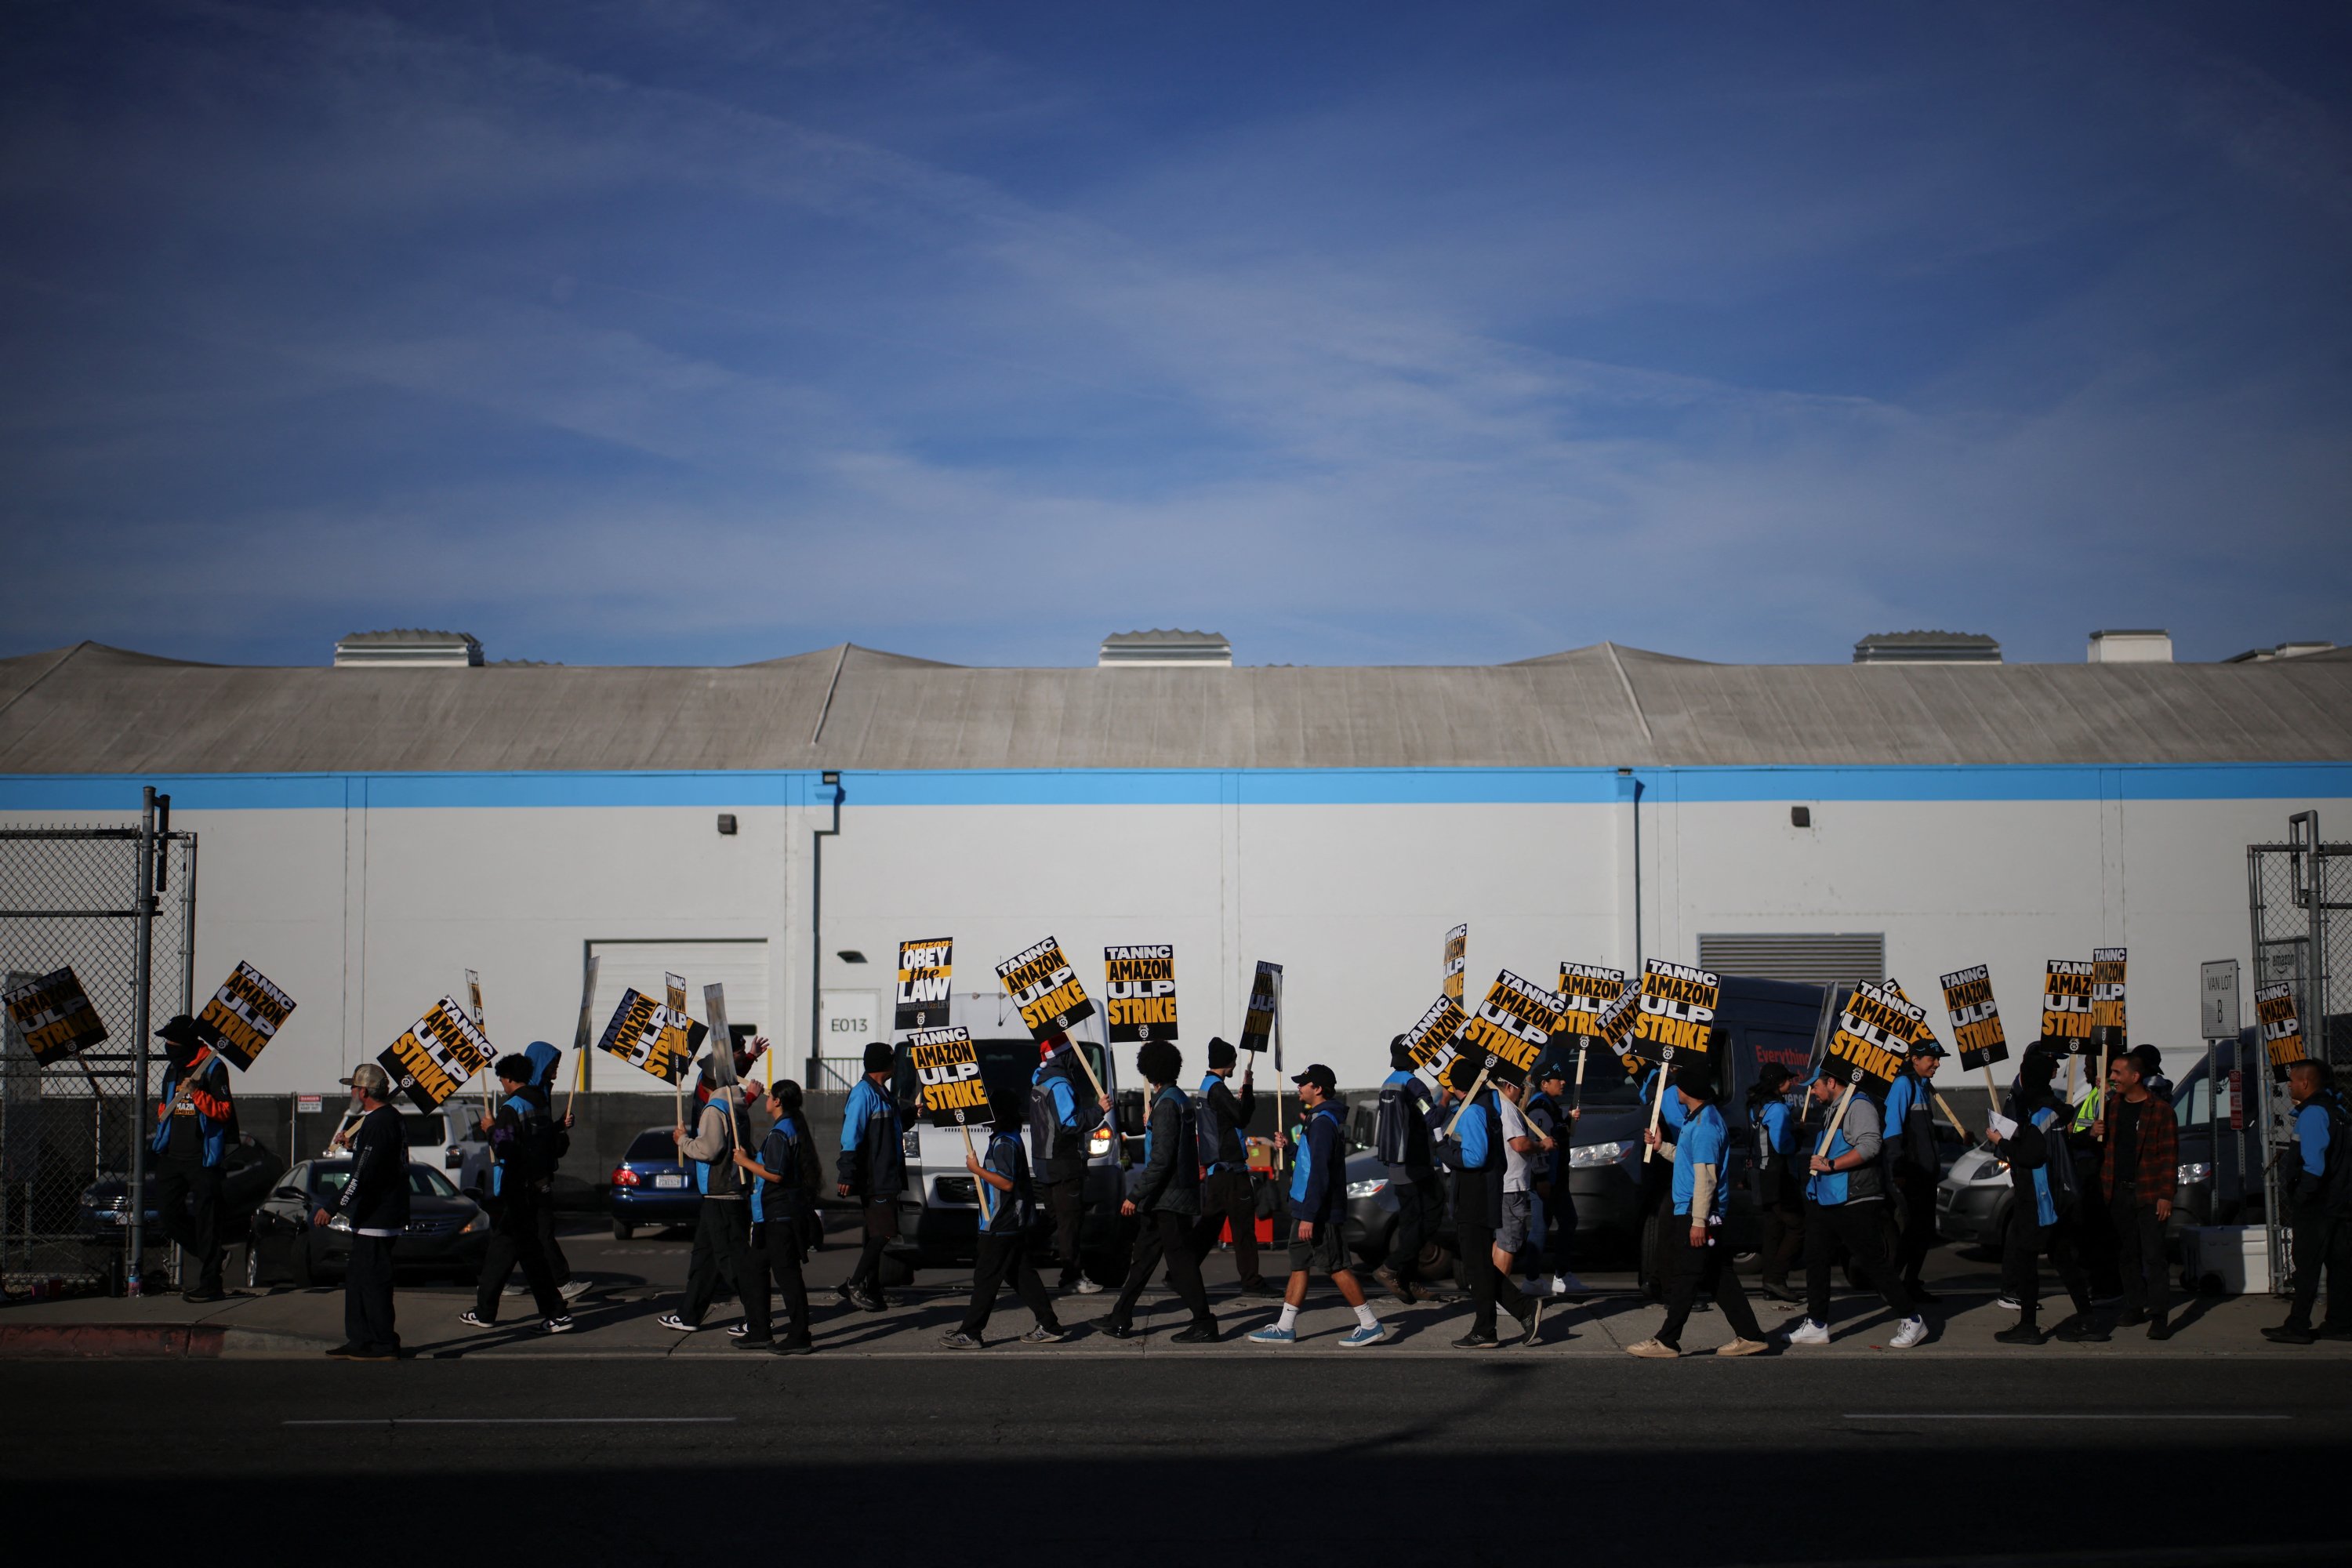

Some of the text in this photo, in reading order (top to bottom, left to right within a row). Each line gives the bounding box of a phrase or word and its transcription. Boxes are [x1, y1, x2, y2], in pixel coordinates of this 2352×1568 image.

[903, 946, 949, 970] OBEY
[998, 938, 1055, 976] TANNC
[1107, 946, 1171, 960] TANNC
[2094, 949, 2125, 962] TANNC
[2273, 954, 2295, 967] amazon
[909, 967, 939, 982] the
[1007, 949, 1065, 993] AMAZON
[1109, 960, 1172, 980] AMAZON
[1563, 963, 1622, 982] TANNC
[1650, 960, 1717, 986] TANNC
[1942, 966, 1987, 989] TANNC
[2094, 963, 2125, 983] AMAZON
[2208, 975, 2232, 991] VAN LOT
[3, 969, 71, 1004] TANNC
[13, 978, 78, 1021] AMAZON
[227, 975, 286, 1025] AMAZON
[241, 962, 293, 1011] TANNC
[898, 977, 950, 1004] LAW
[1011, 966, 1072, 1007] ULP
[1108, 980, 1174, 999] ULP
[1501, 971, 1565, 1013] TANNC
[1561, 976, 1621, 1000] AMAZON
[1645, 975, 1715, 1007] AMAZON
[1860, 981, 1922, 1021] TANNC
[1947, 979, 1992, 1010] AMAZON
[2092, 983, 2125, 1001] ULP
[2256, 984, 2289, 1004] TANNC
[16, 995, 88, 1034] ULP
[216, 985, 276, 1036] ULP
[601, 991, 637, 1046] TANNC
[667, 1008, 686, 1031] ULP
[937, 1000, 949, 1009] LEY
[1022, 978, 1087, 1029] STRIKE
[1109, 996, 1176, 1025] STRIKE
[1489, 985, 1559, 1033] AMAZON
[1596, 982, 1642, 1028] TANNC
[1639, 994, 1713, 1023] ULP
[1850, 996, 1918, 1041] AMAZON
[1950, 1000, 1996, 1027] ULP
[2092, 1000, 2122, 1027] STRIKE
[2217, 999, 2223, 1023] B
[2260, 997, 2295, 1023] AMAZON
[25, 1007, 100, 1054] STRIKE
[201, 999, 267, 1059] STRIKE
[441, 997, 494, 1058] TANNC
[613, 996, 656, 1058] AMAZON
[628, 1004, 667, 1067] ULP
[832, 1018, 867, 1032] E013
[909, 1028, 967, 1046] TANNC
[1402, 998, 1450, 1049] TANNC
[1413, 1006, 1465, 1065] AMAZON
[1479, 1001, 1548, 1044] ULP
[1635, 1012, 1711, 1052] STRIKE
[1841, 1011, 1909, 1054] ULP
[1955, 1016, 2005, 1053] STRIKE
[2263, 1018, 2299, 1041] ULP
[412, 1018, 469, 1083] ULP
[426, 1008, 484, 1072] AMAZON
[916, 1041, 974, 1067] AMAZON
[1465, 1017, 1541, 1072] STRIKE
[1829, 1029, 1903, 1083] STRIKE
[2267, 1035, 2307, 1066] STRIKE
[392, 1032, 458, 1105] STRIKE
[917, 1063, 978, 1085] ULP
[924, 1080, 988, 1111] STRIKE
